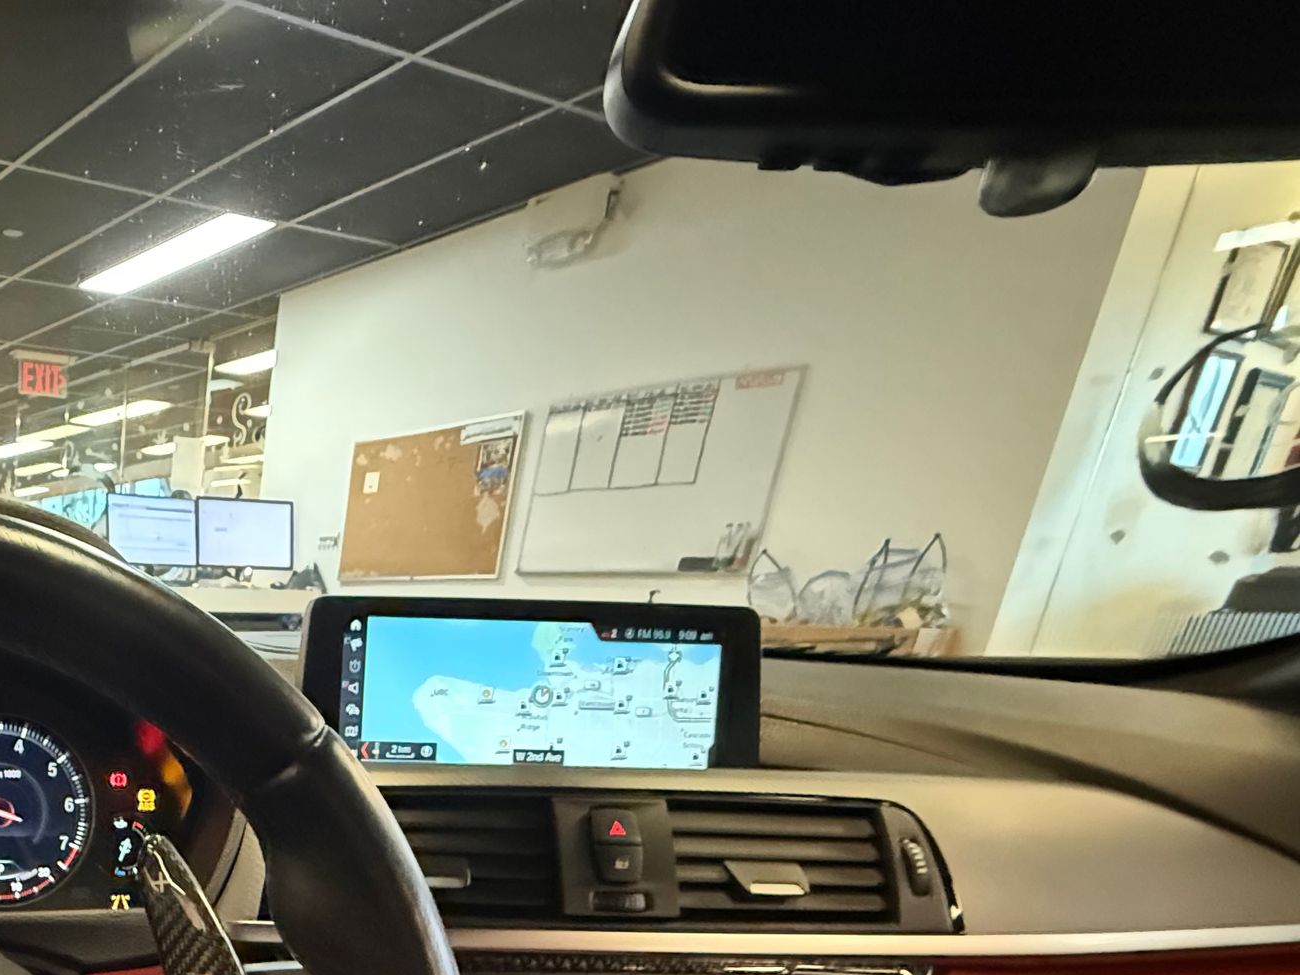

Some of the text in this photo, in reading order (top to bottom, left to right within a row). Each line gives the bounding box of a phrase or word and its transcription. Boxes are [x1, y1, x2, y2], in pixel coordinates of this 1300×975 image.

[23, 362, 61, 398] EXIT
[13, 739, 24, 753] 4
[526, 752, 543, 762] 2nd
[47, 763, 58, 777] 5
[64, 799, 75, 813] 6
[59, 836, 69, 850] 7
